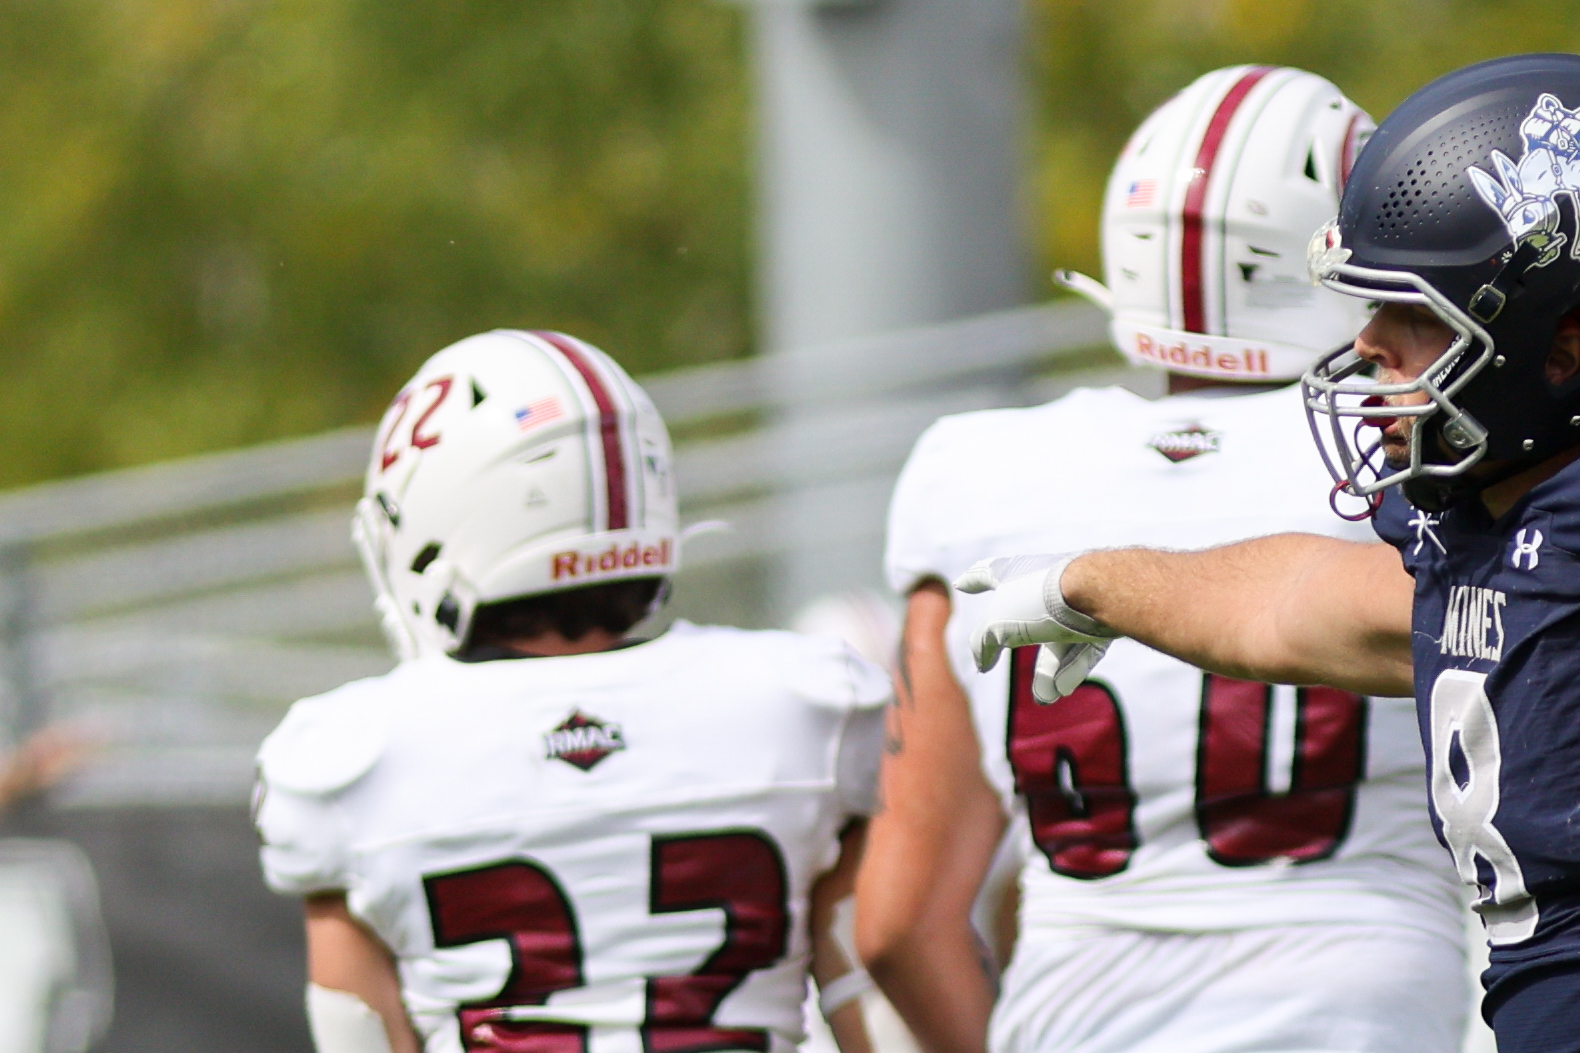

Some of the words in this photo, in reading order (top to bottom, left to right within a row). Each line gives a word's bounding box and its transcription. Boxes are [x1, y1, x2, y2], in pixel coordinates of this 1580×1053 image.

[1135, 331, 1269, 373] Riddell
[379, 373, 454, 473] 22
[1440, 585, 1507, 662] MINES
[543, 723, 623, 759] RMAC
[1430, 668, 1540, 946] 8
